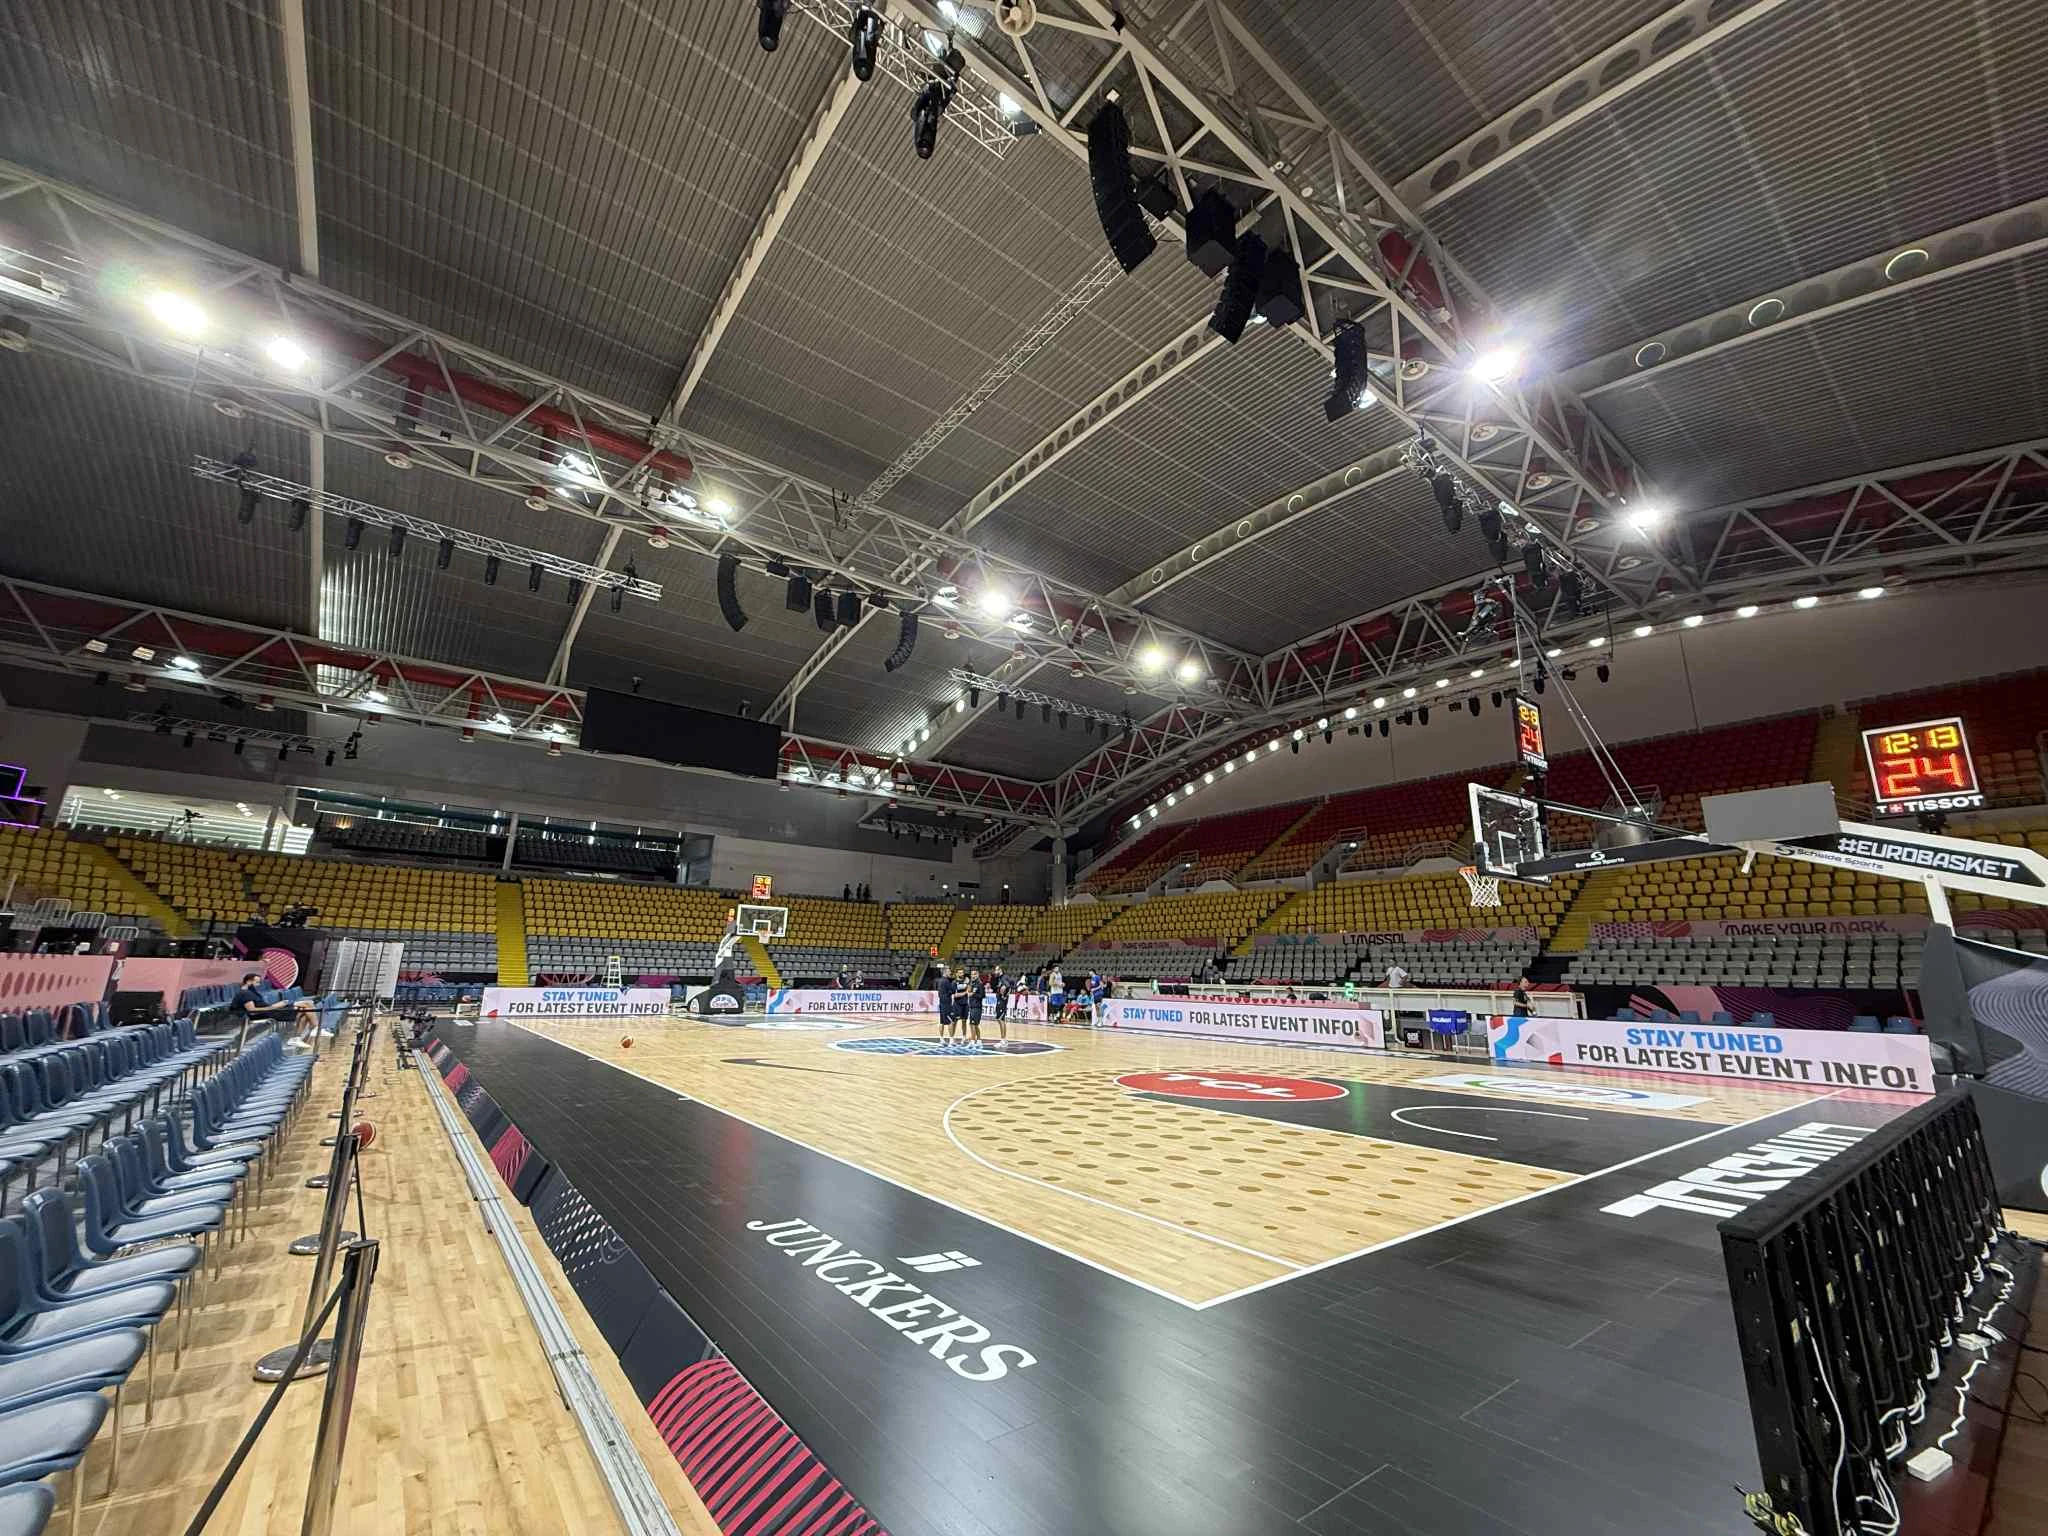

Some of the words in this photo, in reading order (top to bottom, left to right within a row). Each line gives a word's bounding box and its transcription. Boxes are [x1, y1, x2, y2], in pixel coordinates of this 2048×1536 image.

[1882, 726, 1960, 754] 12:13
[1881, 753, 1965, 794] 24
[1903, 794, 1984, 813] TISSOT
[1838, 837, 2019, 878] #EUROBASKET
[1844, 857, 1884, 870] Sports
[1342, 933, 1408, 946] LIMASSOL
[1725, 922, 1776, 937] MAKE
[1776, 921, 1827, 936] YOUR
[542, 991, 575, 1001] STAY
[577, 991, 618, 1001] TUNED
[830, 992, 850, 1002] STAY
[850, 992, 882, 1002] TUNED
[508, 1002, 534, 1014] FOR
[537, 1002, 582, 1014] LATEST
[586, 1002, 628, 1014] EVENT
[630, 1002, 664, 1014] INFO!
[808, 1002, 826, 1012] FOR
[827, 1002, 859, 1012] LATEST
[861, 1002, 888, 1012] EVENT
[890, 1003, 914, 1013] INFO!
[1122, 1007, 1146, 1020] STAY
[1149, 1008, 1183, 1022] TUNED
[1190, 1011, 1210, 1025] FOR
[1213, 1012, 1259, 1029] LATEST
[1262, 1015, 1309, 1033] EVENT
[1313, 1018, 1361, 1037] INFO!
[1627, 1027, 1686, 1049] STAY
[1690, 1031, 1784, 1054] TUNED
[1576, 1043, 1619, 1063] FOR
[1625, 1046, 1711, 1071] LATEST
[1719, 1053, 1813, 1081] EVENT
[1821, 1060, 1920, 1090] INFO!
[1159, 1073, 1297, 1098] TCL
[746, 1217, 1039, 1382] JUNCKERS
